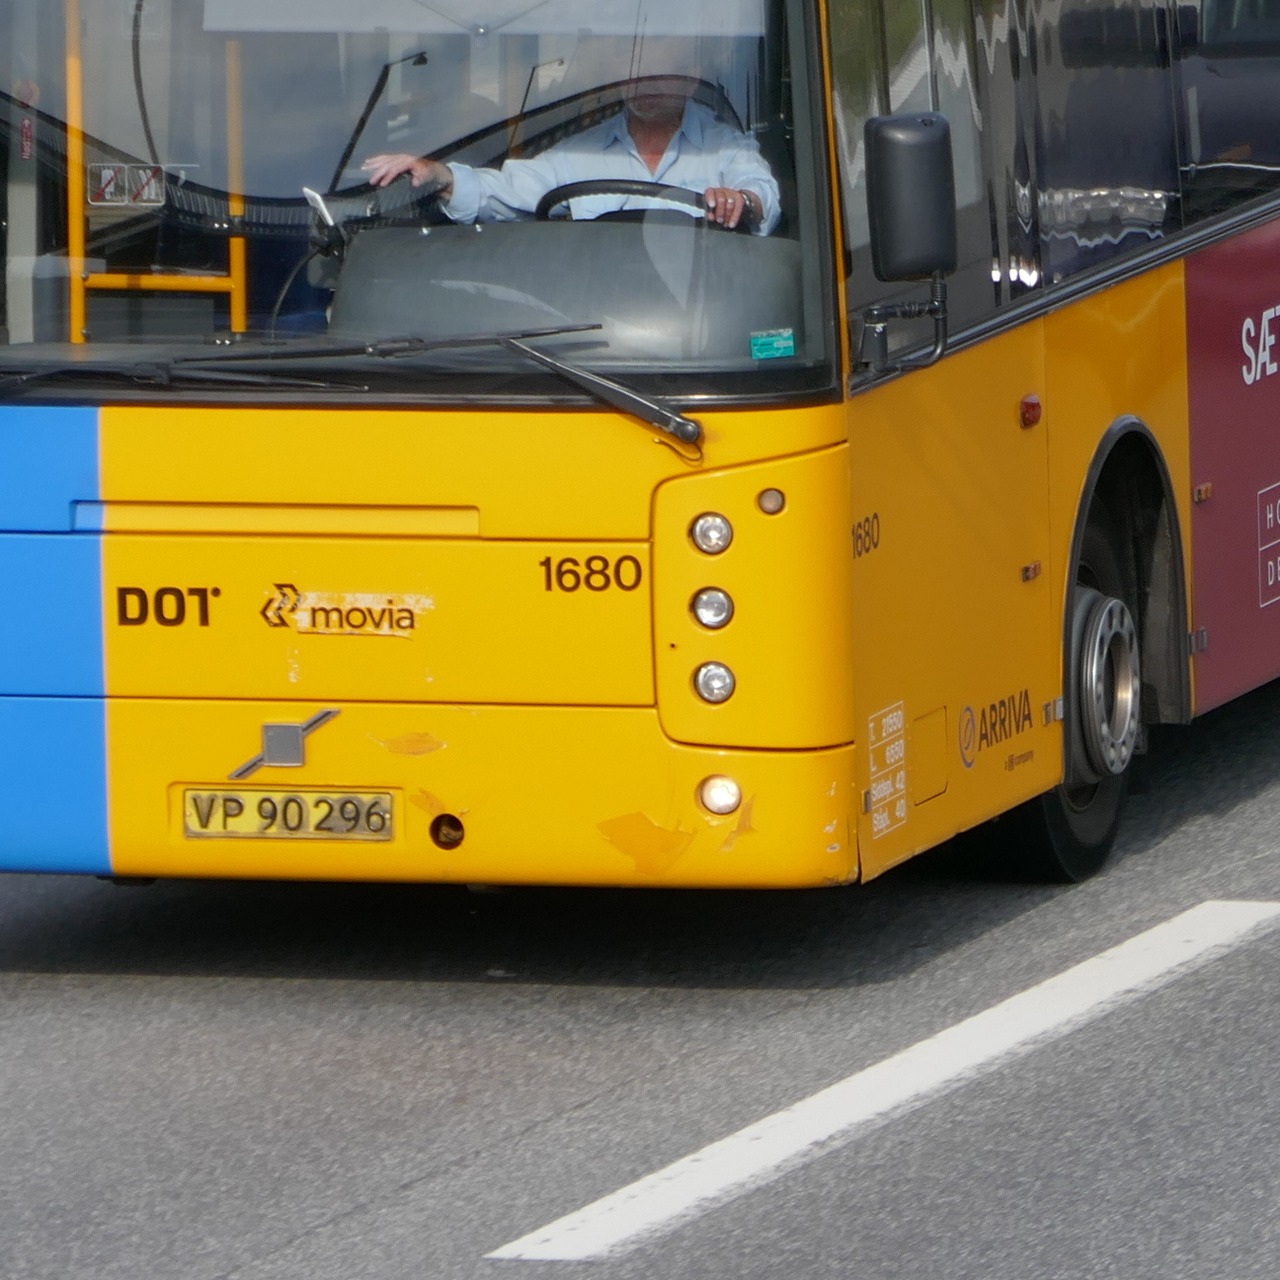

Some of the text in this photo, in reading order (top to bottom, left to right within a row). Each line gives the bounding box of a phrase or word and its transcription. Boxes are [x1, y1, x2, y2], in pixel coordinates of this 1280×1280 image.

[852, 513, 880, 559] 1680
[539, 554, 642, 593] 1680
[117, 586, 221, 627] DOT
[310, 598, 415, 630] movia
[978, 689, 1033, 752] ARRIVA
[191, 795, 245, 832] VP
